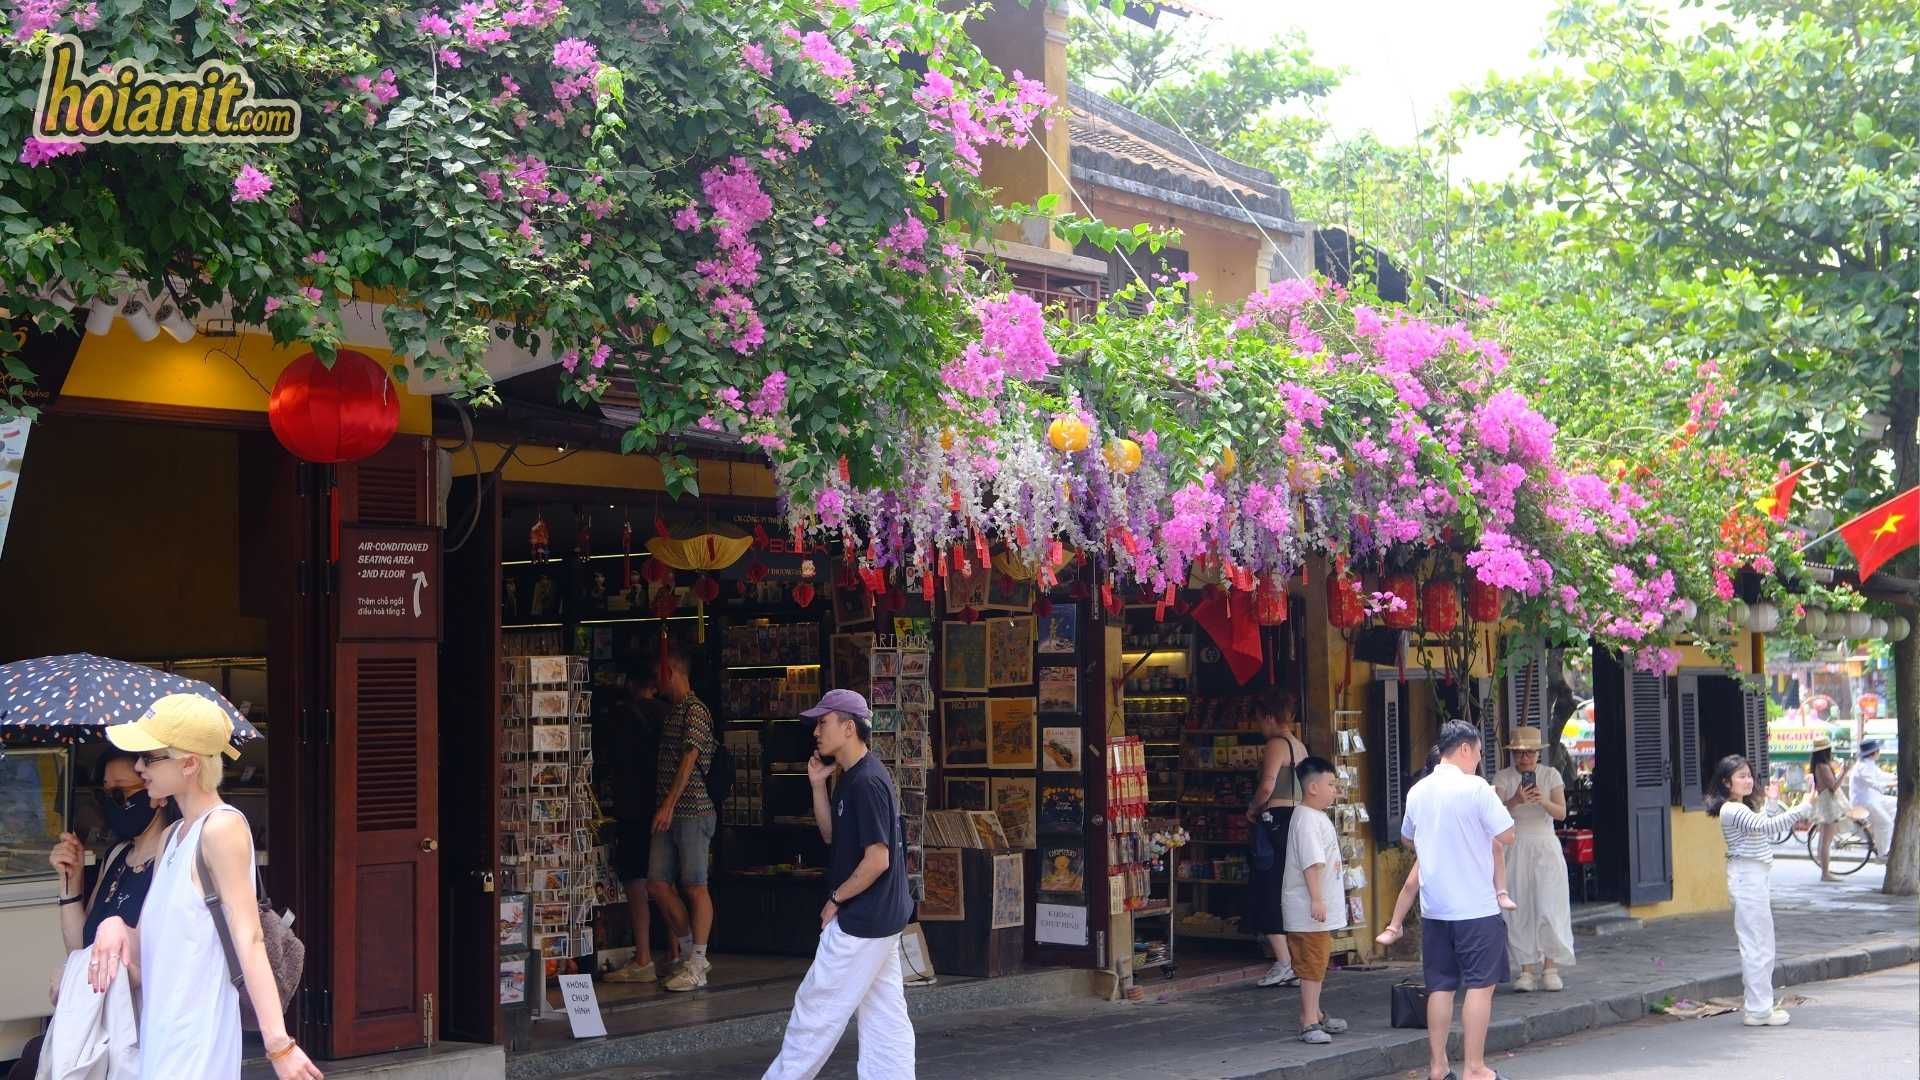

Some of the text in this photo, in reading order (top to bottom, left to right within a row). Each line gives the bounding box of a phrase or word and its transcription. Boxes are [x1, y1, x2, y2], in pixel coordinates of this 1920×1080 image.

[358, 542, 429, 552] AIR-CONDITIONED
[358, 555, 414, 565] SEATING AREA
[380, 569, 406, 578] FLOOR
[401, 608, 406, 616] 2
